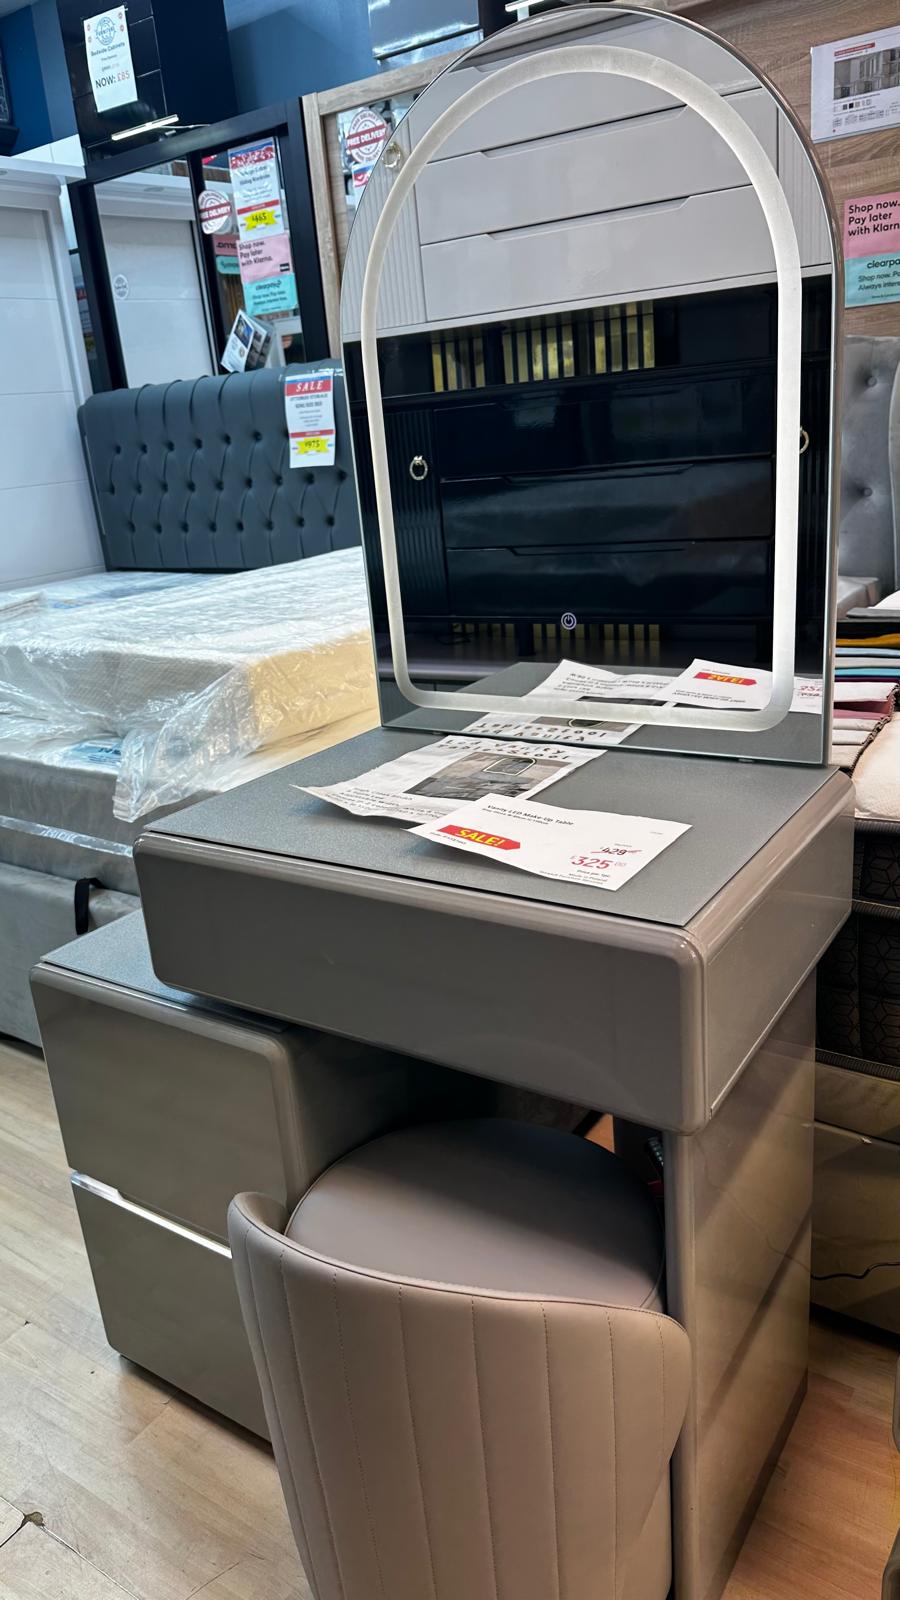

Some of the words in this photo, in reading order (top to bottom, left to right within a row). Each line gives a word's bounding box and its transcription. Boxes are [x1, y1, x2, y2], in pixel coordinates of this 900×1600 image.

[95, 74, 117, 89] NOW:
[848, 203, 874, 215] Shop
[876, 200, 900, 210] now.
[848, 215, 867, 226] Pay
[869, 212, 893, 223] later
[848, 225, 871, 237] with
[873, 222, 900, 234] Klarn
[240, 251, 250, 259] Pay
[866, 258, 900, 271] clearpa
[858, 273, 876, 283] Shop
[858, 281, 882, 291] Always
[296, 380, 324, 393] SALE
[487, 804, 507, 813] Vanity
[459, 829, 506, 847] SALE!
